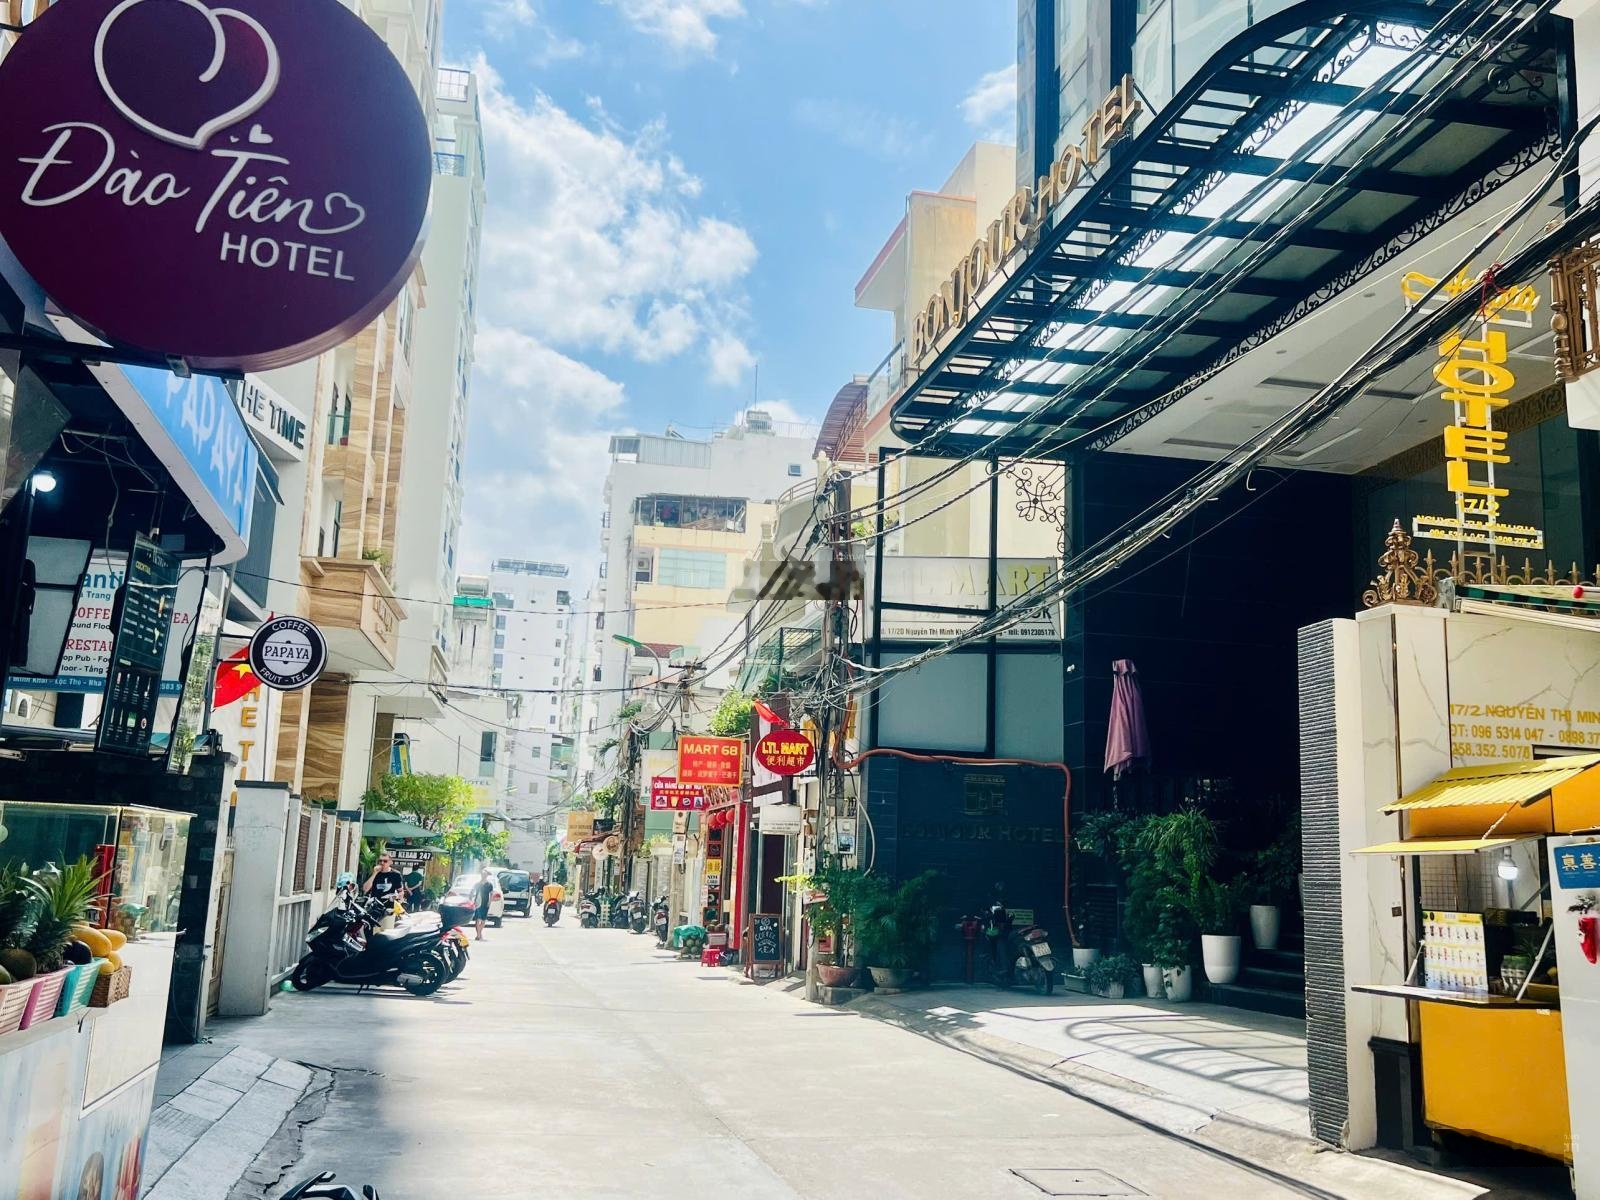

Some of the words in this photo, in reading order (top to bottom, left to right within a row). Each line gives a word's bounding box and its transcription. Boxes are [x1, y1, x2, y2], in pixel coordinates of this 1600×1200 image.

[18, 121, 190, 206] Đào
[195, 147, 366, 235] Tiên
[912, 184, 1036, 366] BONJOUR
[1037, 73, 1143, 222] HOTEL
[220, 231, 355, 281] HOTEL
[1432, 331, 1515, 497] HOTEL
[269, 399, 306, 450] TIME
[87, 591, 111, 601] Trang
[272, 620, 310, 634] COFFEE
[264, 645, 309, 660] PAPAYA
[260, 667, 283, 683] FRUIT
[291, 672, 309, 684] TEA
[1450, 703, 1480, 717] 17/2
[1550, 708, 1572, 725] THỊ
[1471, 724, 1492, 739] 096
[1496, 726, 1521, 740] 5314
[1524, 727, 1544, 742] 047
[684, 743, 719, 756] MART
[721, 745, 738, 757] 68
[762, 741, 779, 755] LTL
[781, 742, 810, 756] MART
[766, 755, 806, 767] 便利超市
